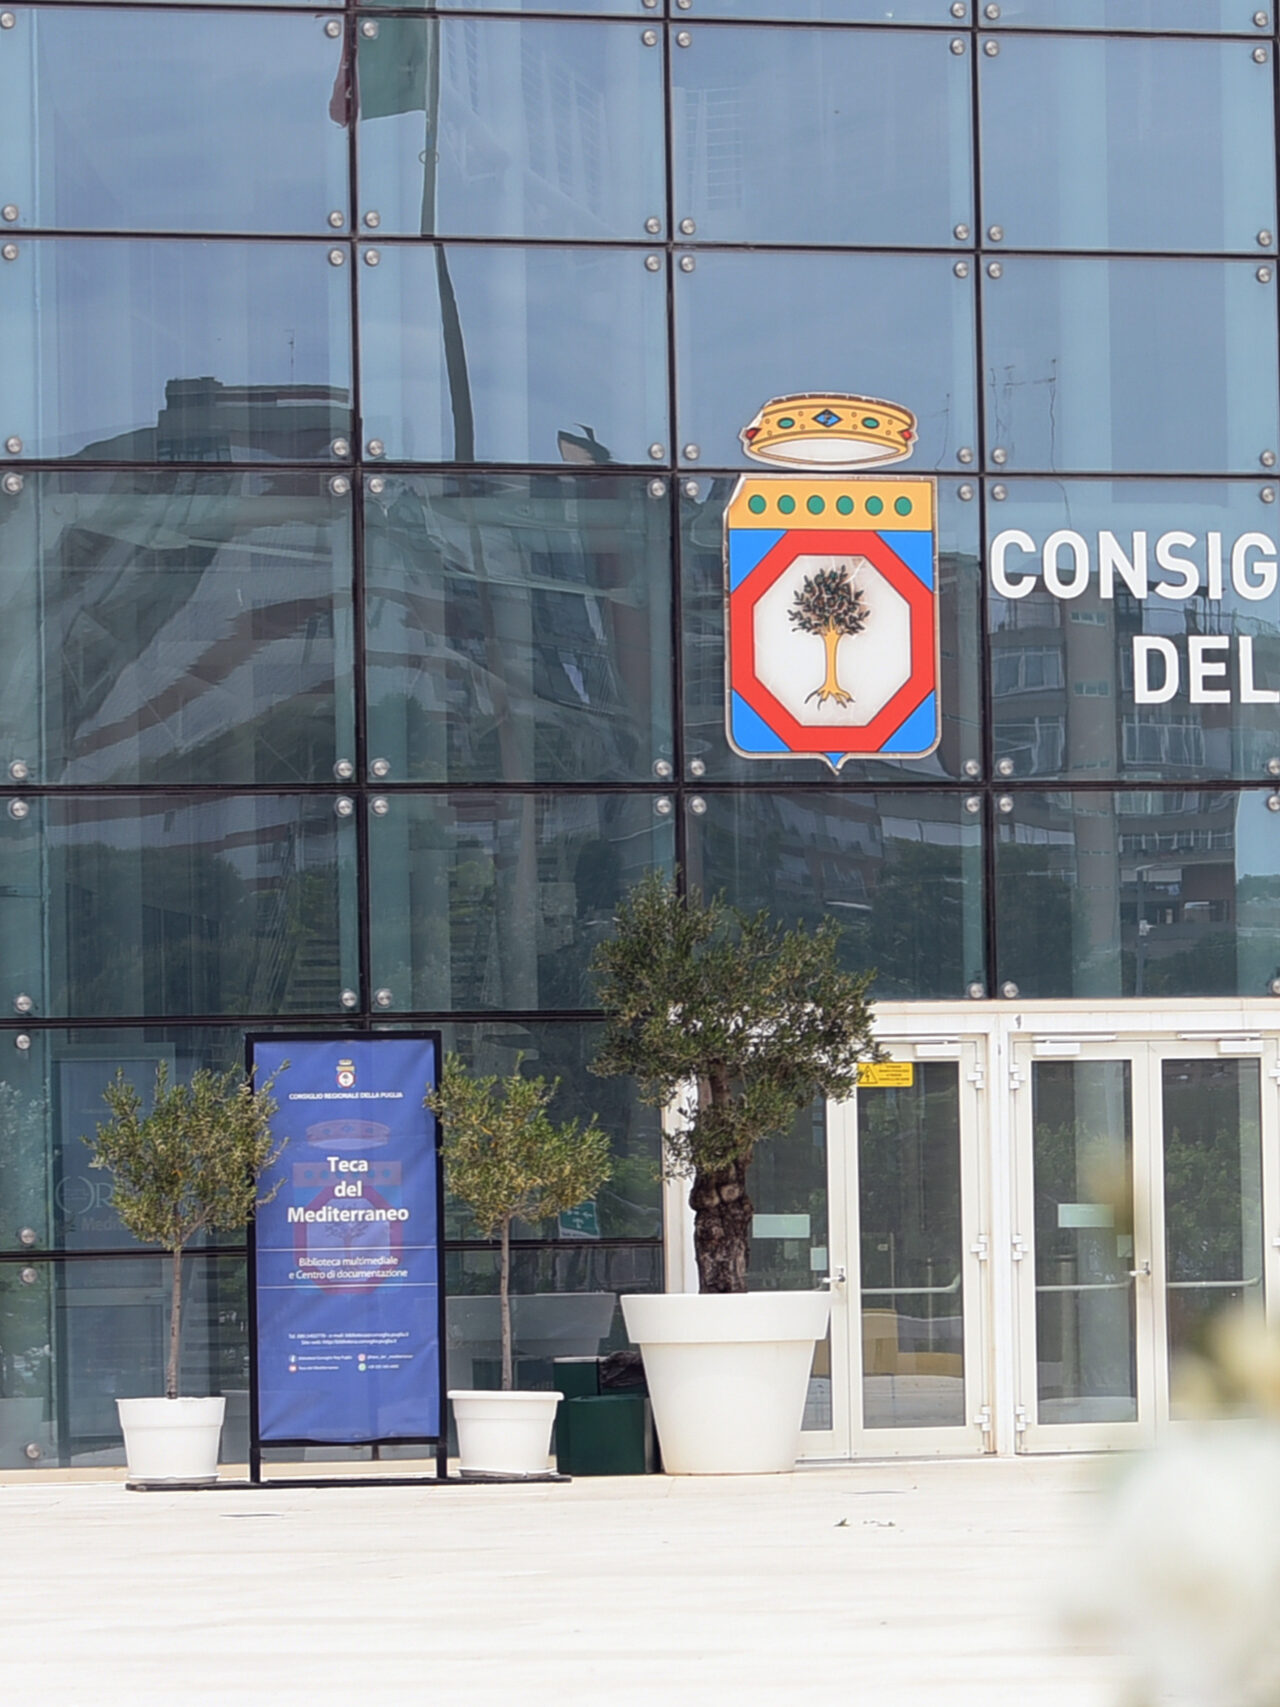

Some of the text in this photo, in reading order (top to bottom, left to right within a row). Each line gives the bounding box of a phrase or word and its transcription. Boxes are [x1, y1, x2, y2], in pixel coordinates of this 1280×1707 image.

[327, 1157, 368, 1172] Teca
[334, 1180, 363, 1198] del
[288, 1206, 409, 1222] Mediterraneo
[299, 1256, 398, 1266] Biblioteca multimediale
[296, 1270, 325, 1279] Centro
[327, 1269, 335, 1278] di
[337, 1268, 408, 1278] documentazione
